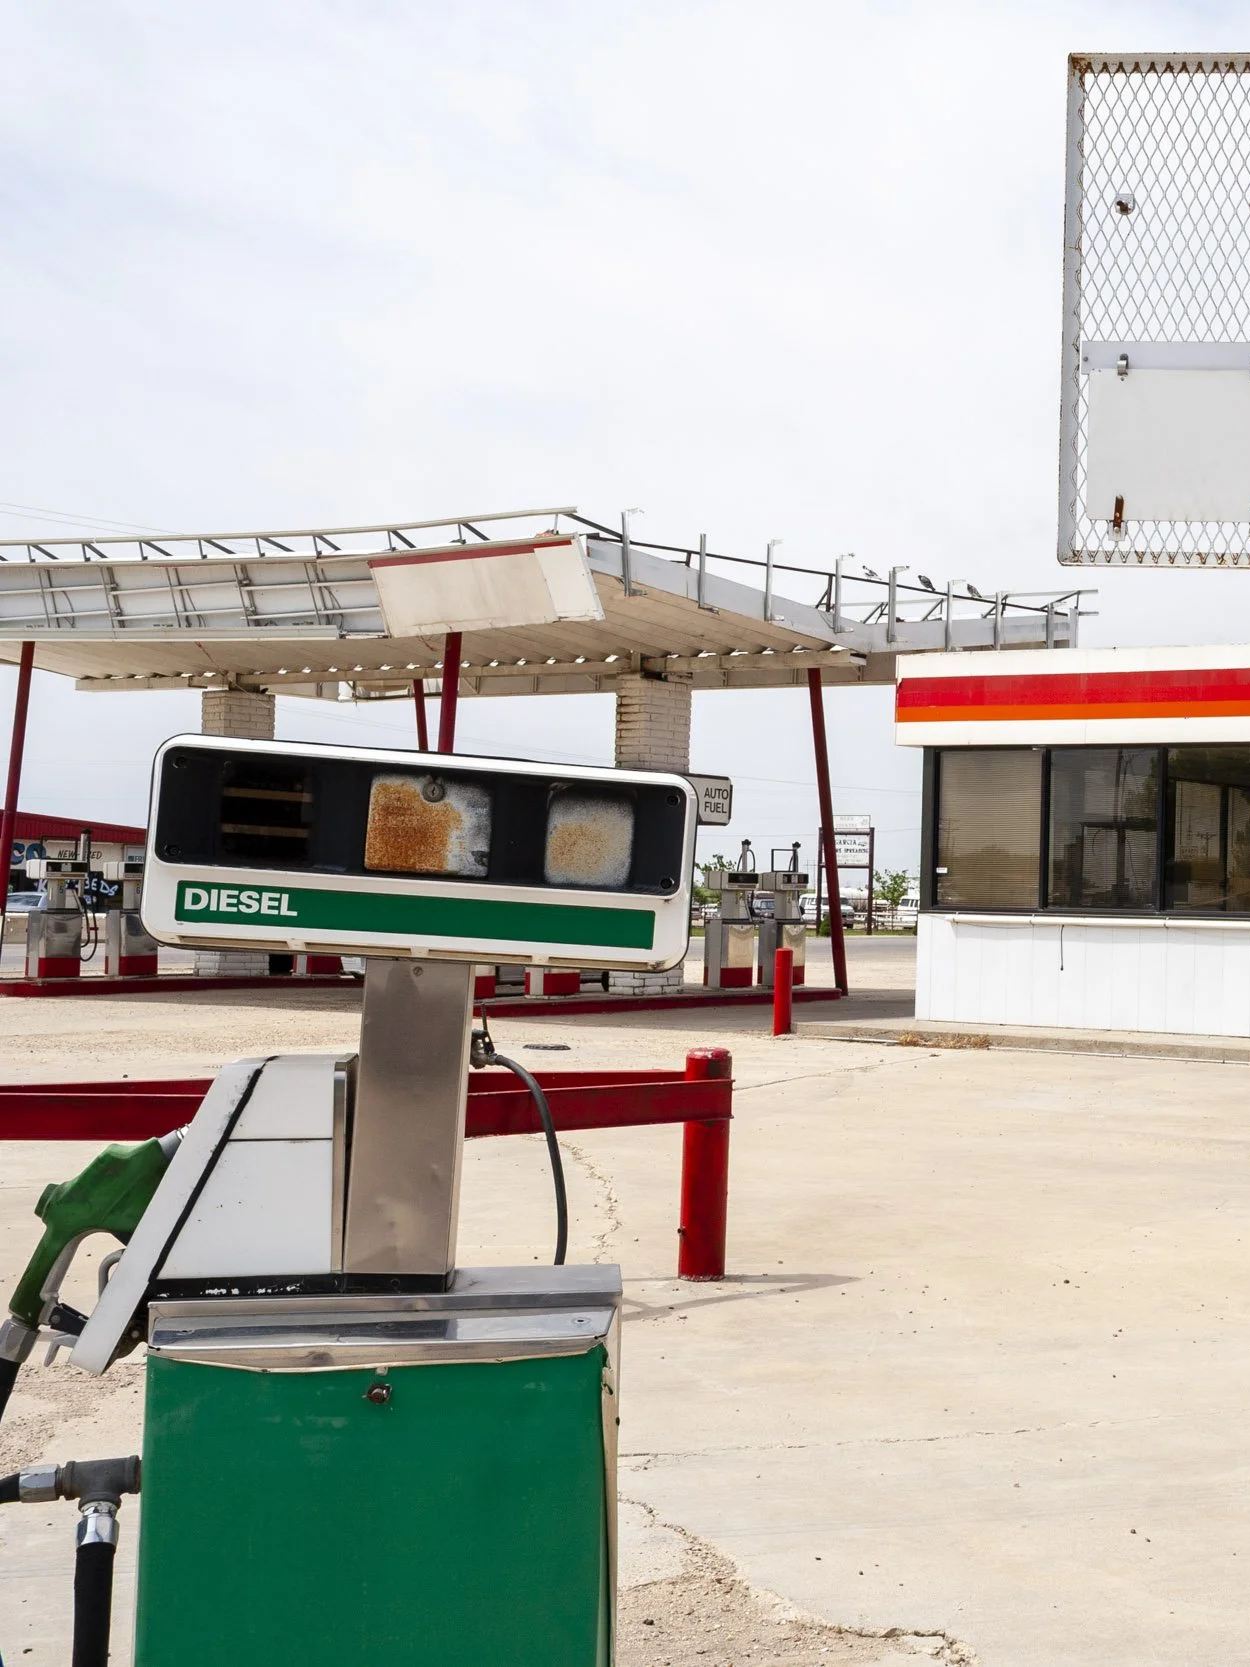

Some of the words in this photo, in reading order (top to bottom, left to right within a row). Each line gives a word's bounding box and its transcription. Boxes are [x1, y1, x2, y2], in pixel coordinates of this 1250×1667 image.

[704, 787, 729, 800] AUTO
[704, 801, 728, 814] FUEL
[183, 887, 298, 917] DIESEL
